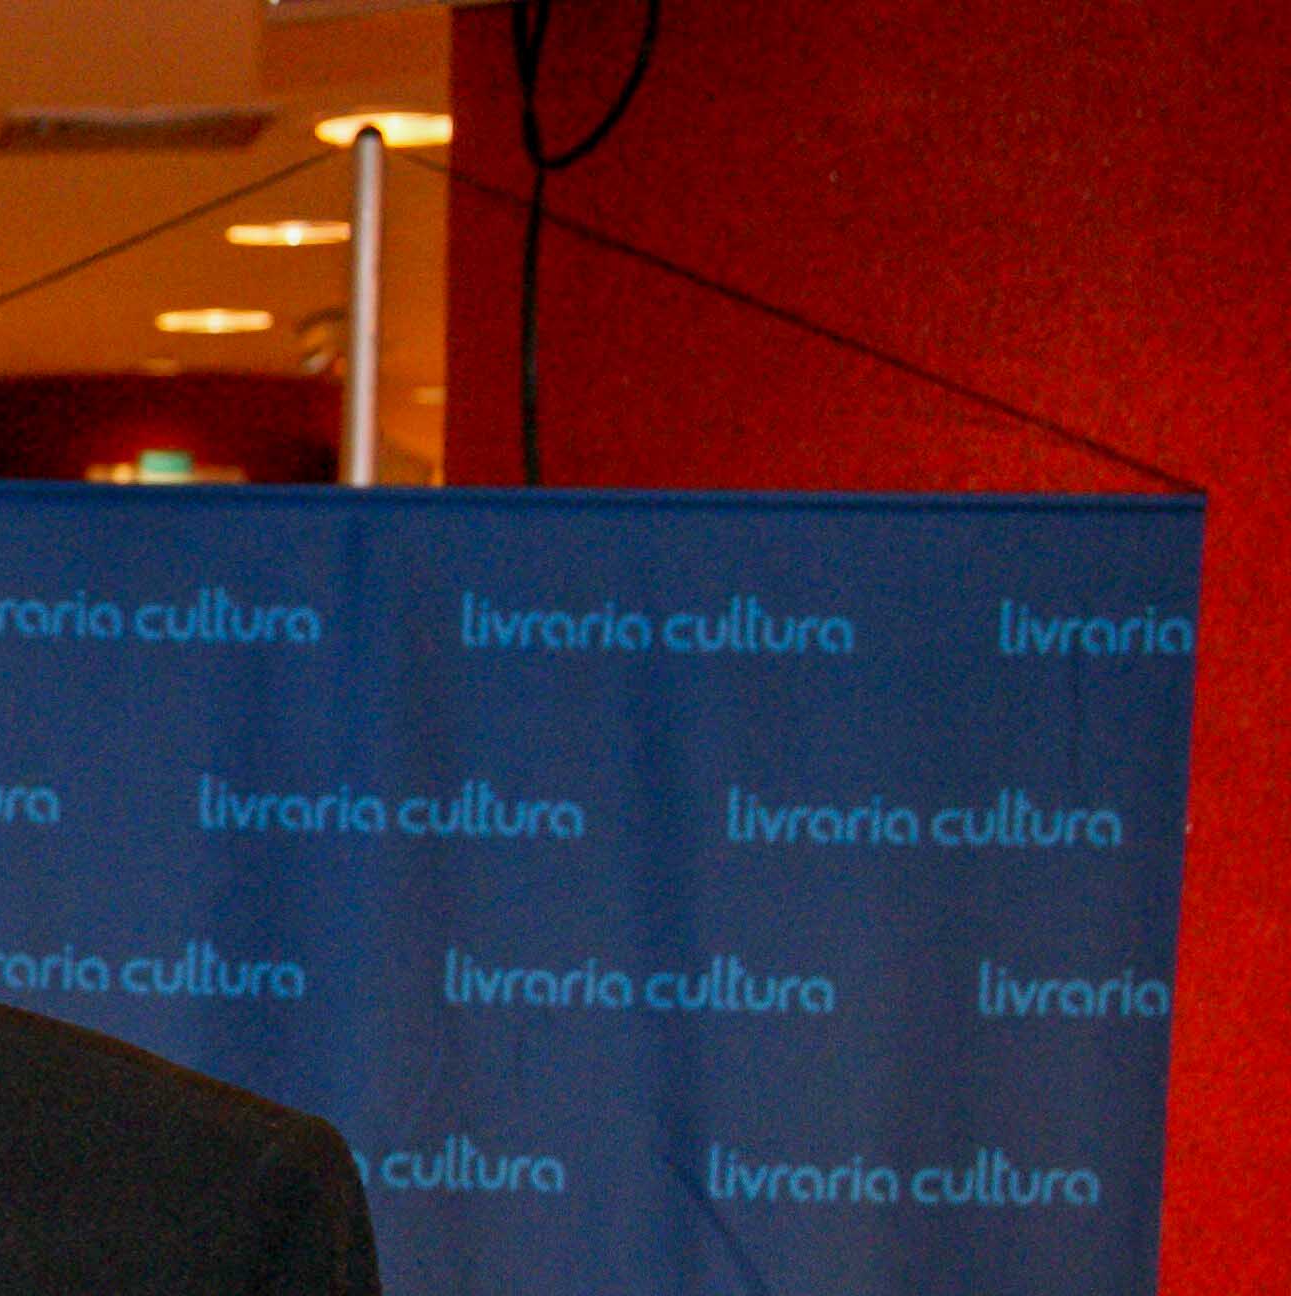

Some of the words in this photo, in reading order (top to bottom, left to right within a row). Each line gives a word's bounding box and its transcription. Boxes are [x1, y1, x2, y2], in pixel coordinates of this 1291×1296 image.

[133, 587, 320, 645] cultura
[461, 593, 653, 652] livraria
[662, 597, 855, 655] cultura
[999, 600, 1196, 657] livraria
[198, 774, 386, 835] livraria
[397, 779, 586, 840] cultura
[727, 785, 919, 845] livraria
[929, 789, 1123, 849] cultura
[119, 941, 306, 1001] cultura
[444, 948, 634, 1008] livraria
[643, 955, 835, 1014] cultura
[978, 961, 1171, 1018] livraria
[378, 1134, 566, 1193] cultura
[707, 1141, 898, 1202] livraria
[909, 1148, 1101, 1206] cultura
